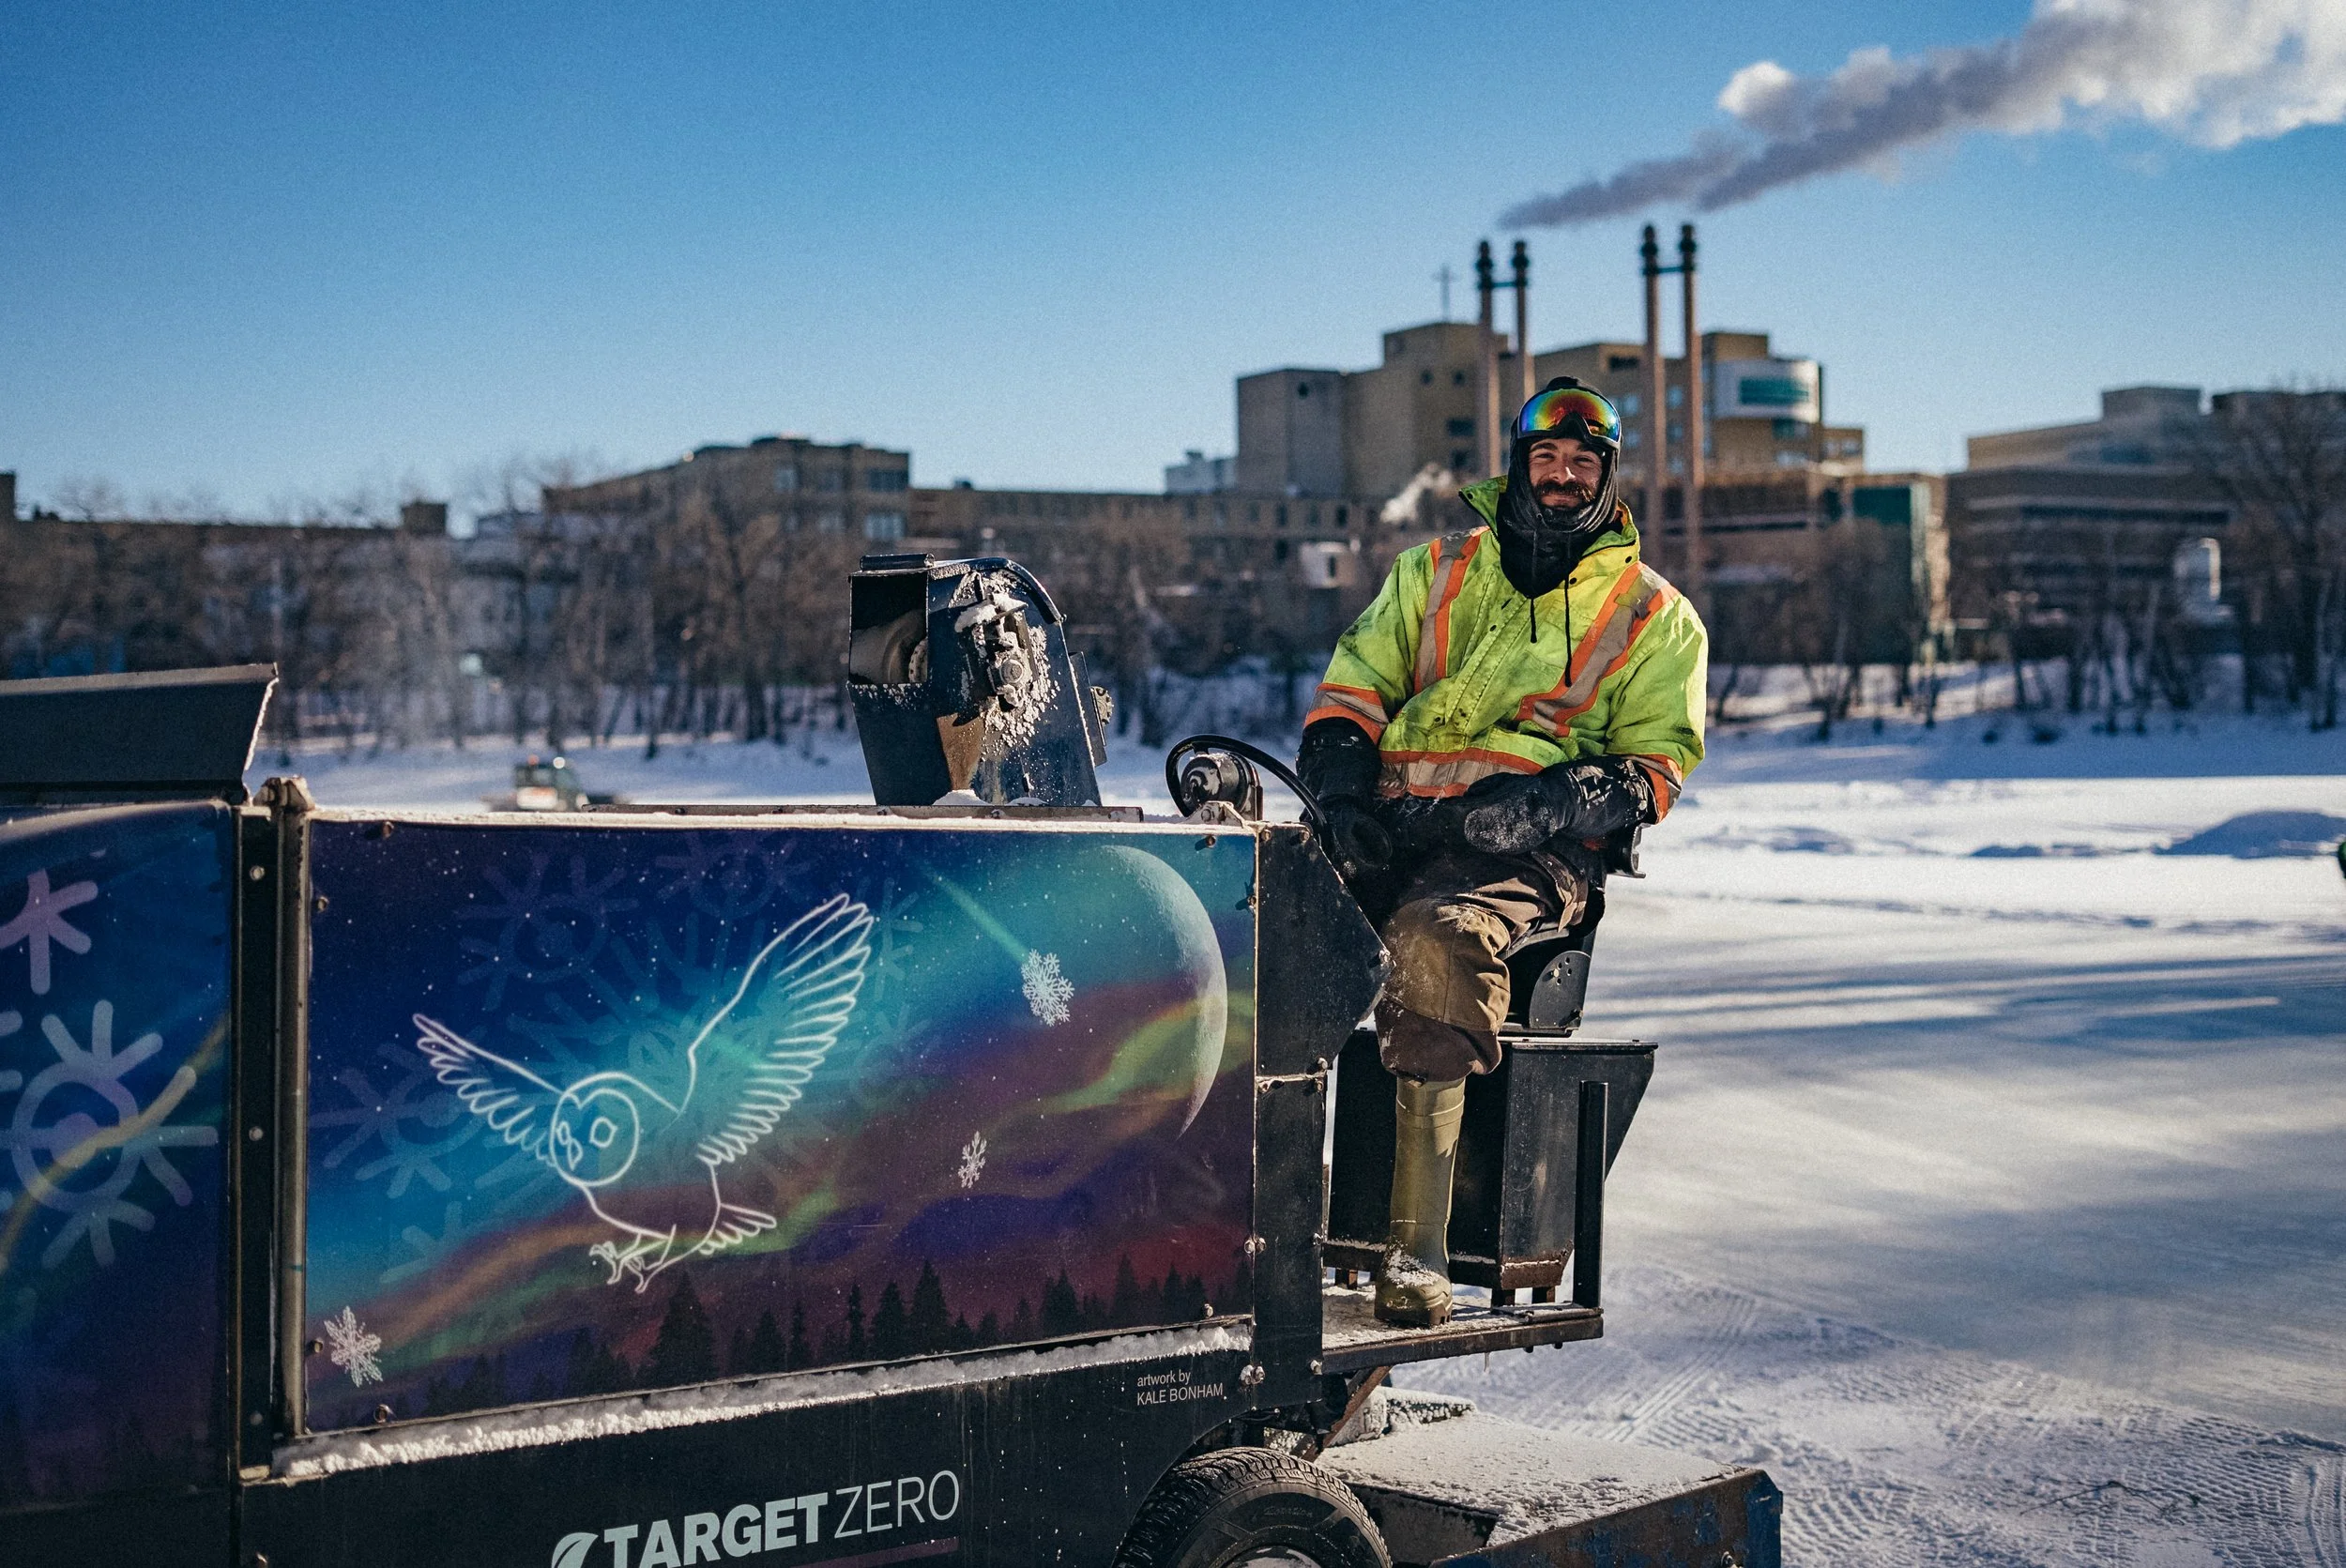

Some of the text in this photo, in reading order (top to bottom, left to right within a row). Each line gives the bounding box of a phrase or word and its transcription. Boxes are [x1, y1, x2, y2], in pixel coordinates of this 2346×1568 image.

[1136, 1369, 1191, 1387] artwork by
[1136, 1382, 1224, 1406] KALE BONHAM
